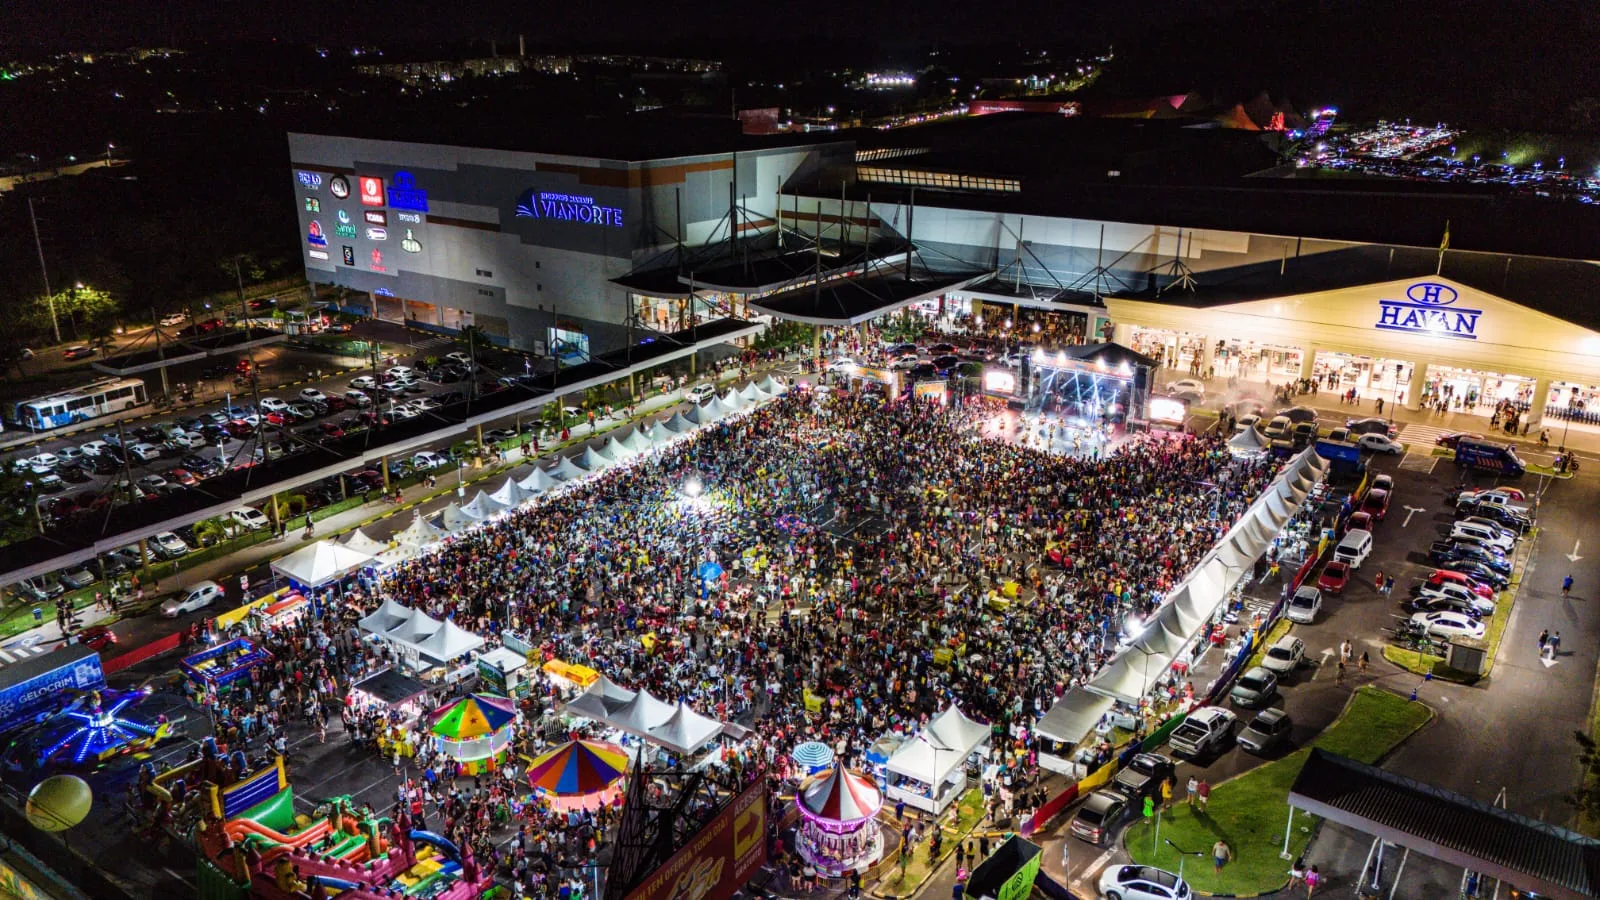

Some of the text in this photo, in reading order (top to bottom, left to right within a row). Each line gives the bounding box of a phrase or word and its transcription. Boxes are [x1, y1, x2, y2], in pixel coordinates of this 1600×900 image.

[540, 200, 623, 227] VIANORTE
[1422, 285, 1443, 303] H
[1378, 305, 1479, 334] HAVAN
[18, 676, 74, 704] GELOCRIM
[734, 781, 763, 817] ACESSO
[664, 850, 693, 881] OFERTA
[693, 832, 713, 854] TODO
